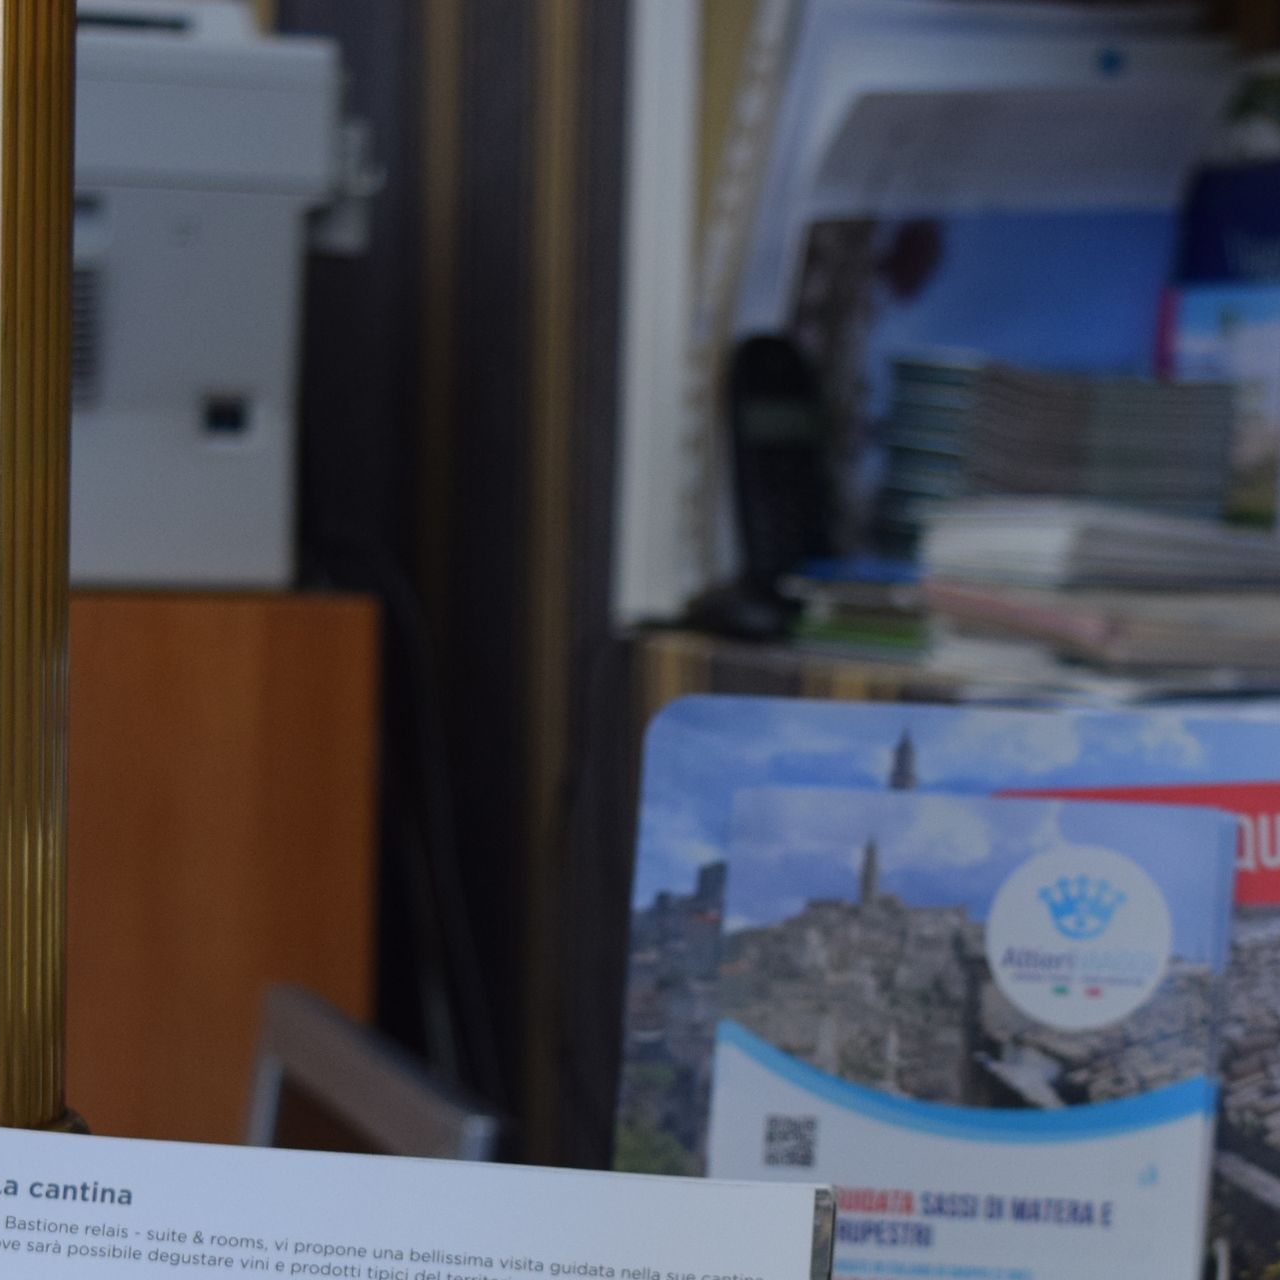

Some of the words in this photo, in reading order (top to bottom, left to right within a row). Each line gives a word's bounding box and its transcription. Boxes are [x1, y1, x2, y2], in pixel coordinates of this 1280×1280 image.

[29, 1180, 133, 1206] cantina
[922, 1191, 979, 1219] SASSI
[984, 1194, 1004, 1221] DI
[1011, 1196, 1095, 1226] MATERA
[5, 1215, 79, 1236] Bastione
[84, 1222, 129, 1239] relais
[147, 1228, 187, 1244] suite
[192, 1230, 205, 1245] &
[210, 1233, 268, 1251] rooms,
[274, 1238, 289, 1252] vi
[294, 1240, 367, 1258] propone
[373, 1247, 404, 1262] una
[410, 1247, 494, 1269] bellissima
[499, 1255, 545, 1273] visita
[550, 1261, 615, 1279] guidata
[27, 1238, 62, 1254] sarà
[67, 1243, 142, 1260] possibile
[148, 1248, 234, 1268] degustare
[240, 1256, 269, 1271] vini
[275, 1260, 285, 1273] e
[290, 1259, 361, 1279] prodotti
